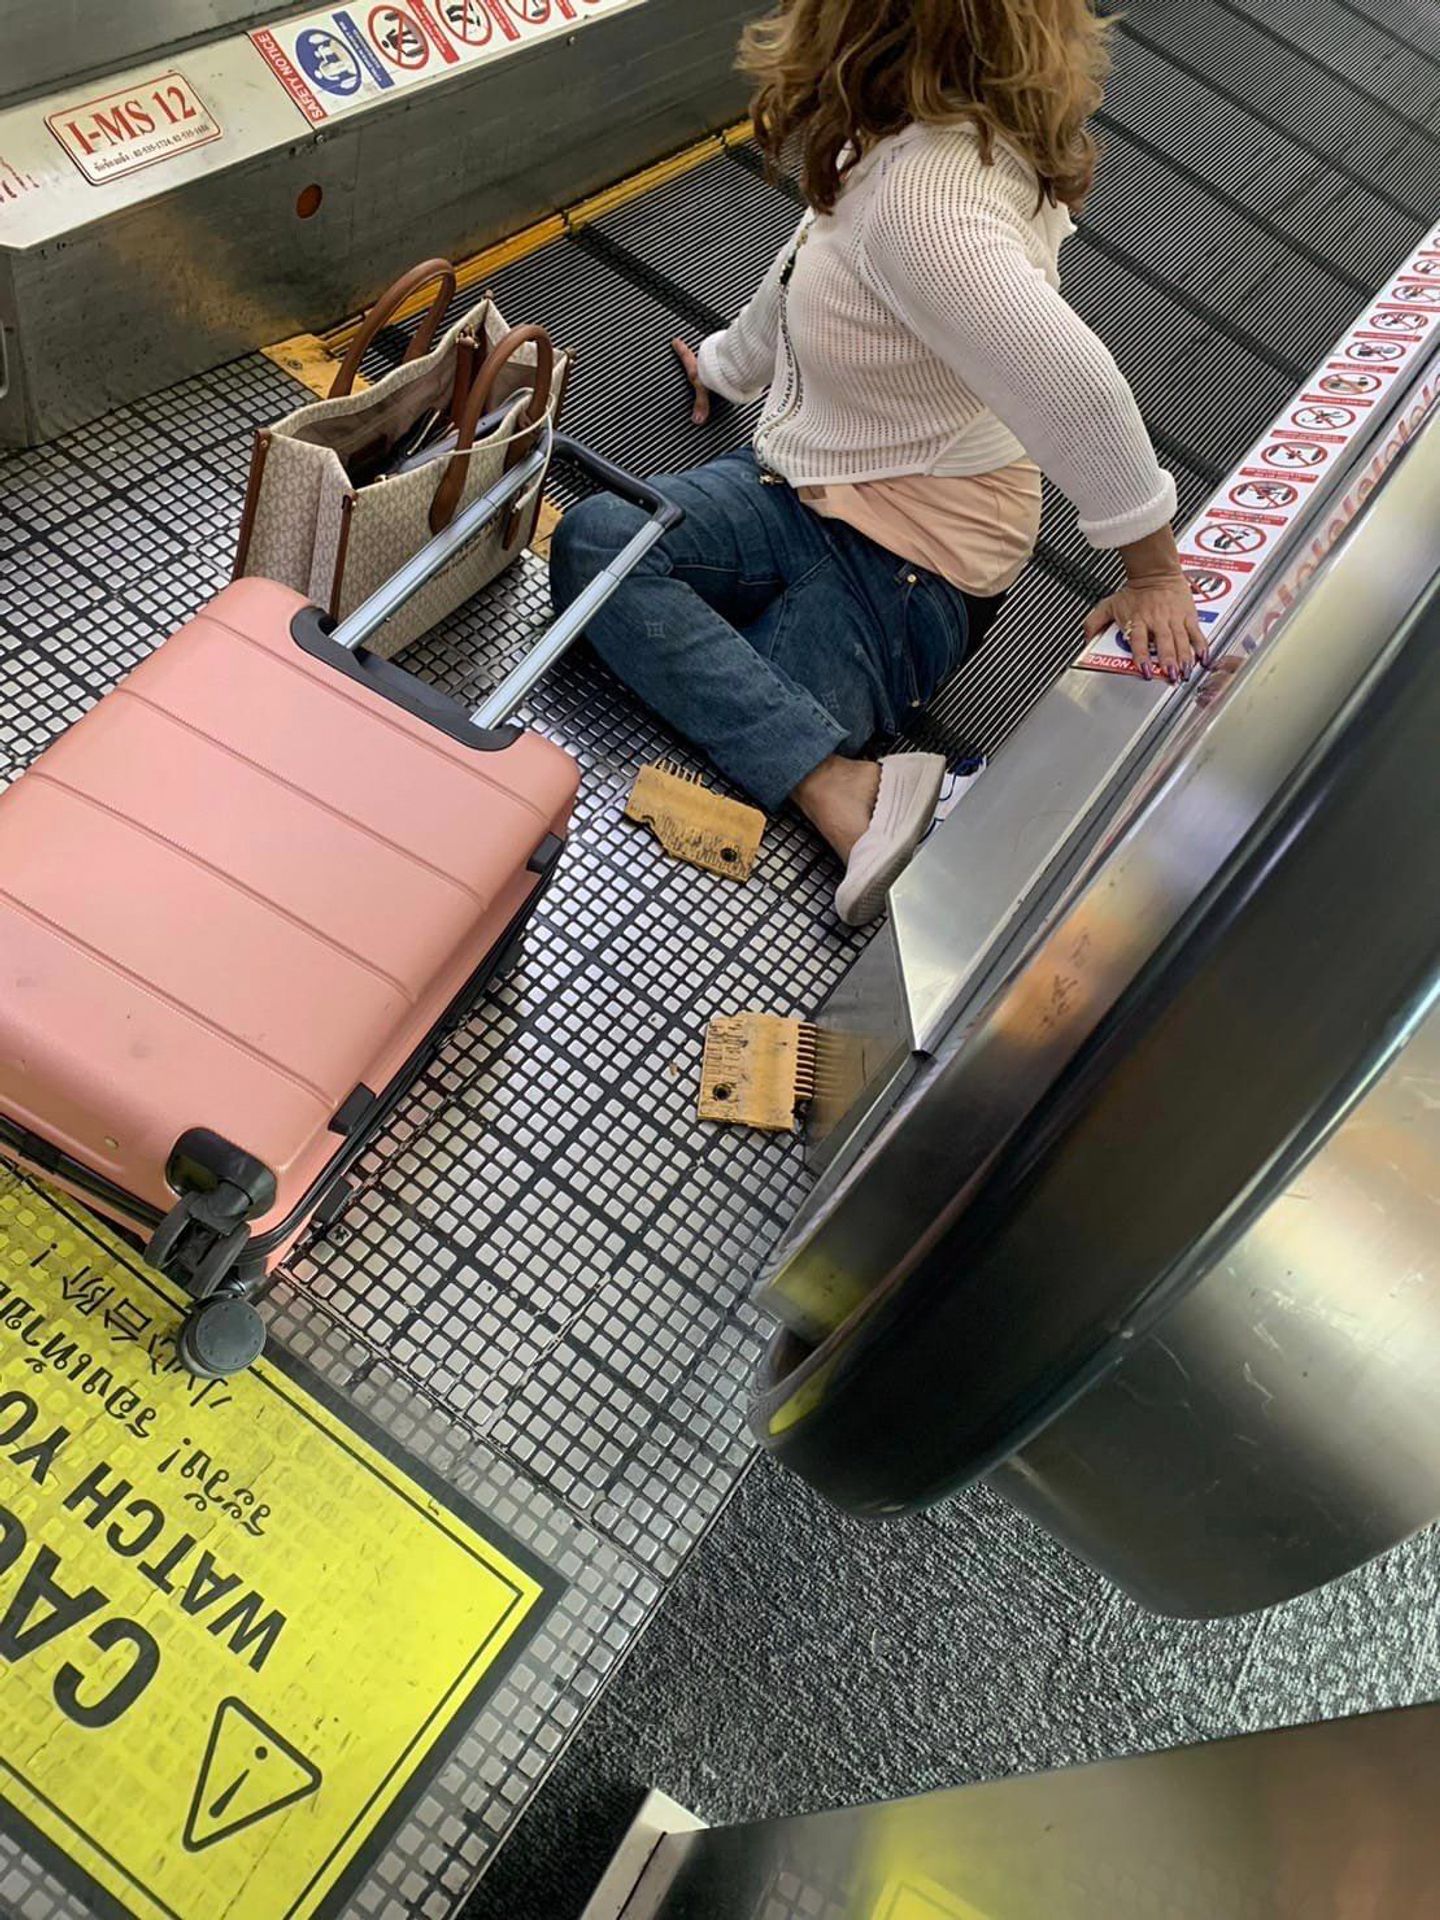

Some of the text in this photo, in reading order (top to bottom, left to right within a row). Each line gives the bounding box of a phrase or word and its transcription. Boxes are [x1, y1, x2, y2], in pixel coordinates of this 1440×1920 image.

[257, 31, 324, 119] SAFETY NOTICE
[65, 86, 197, 156] I-MS 12
[776, 371, 795, 413] CHANEL
[157, 1437, 272, 1537] ระวัง!
[62, 1460, 287, 1673] WATCH
